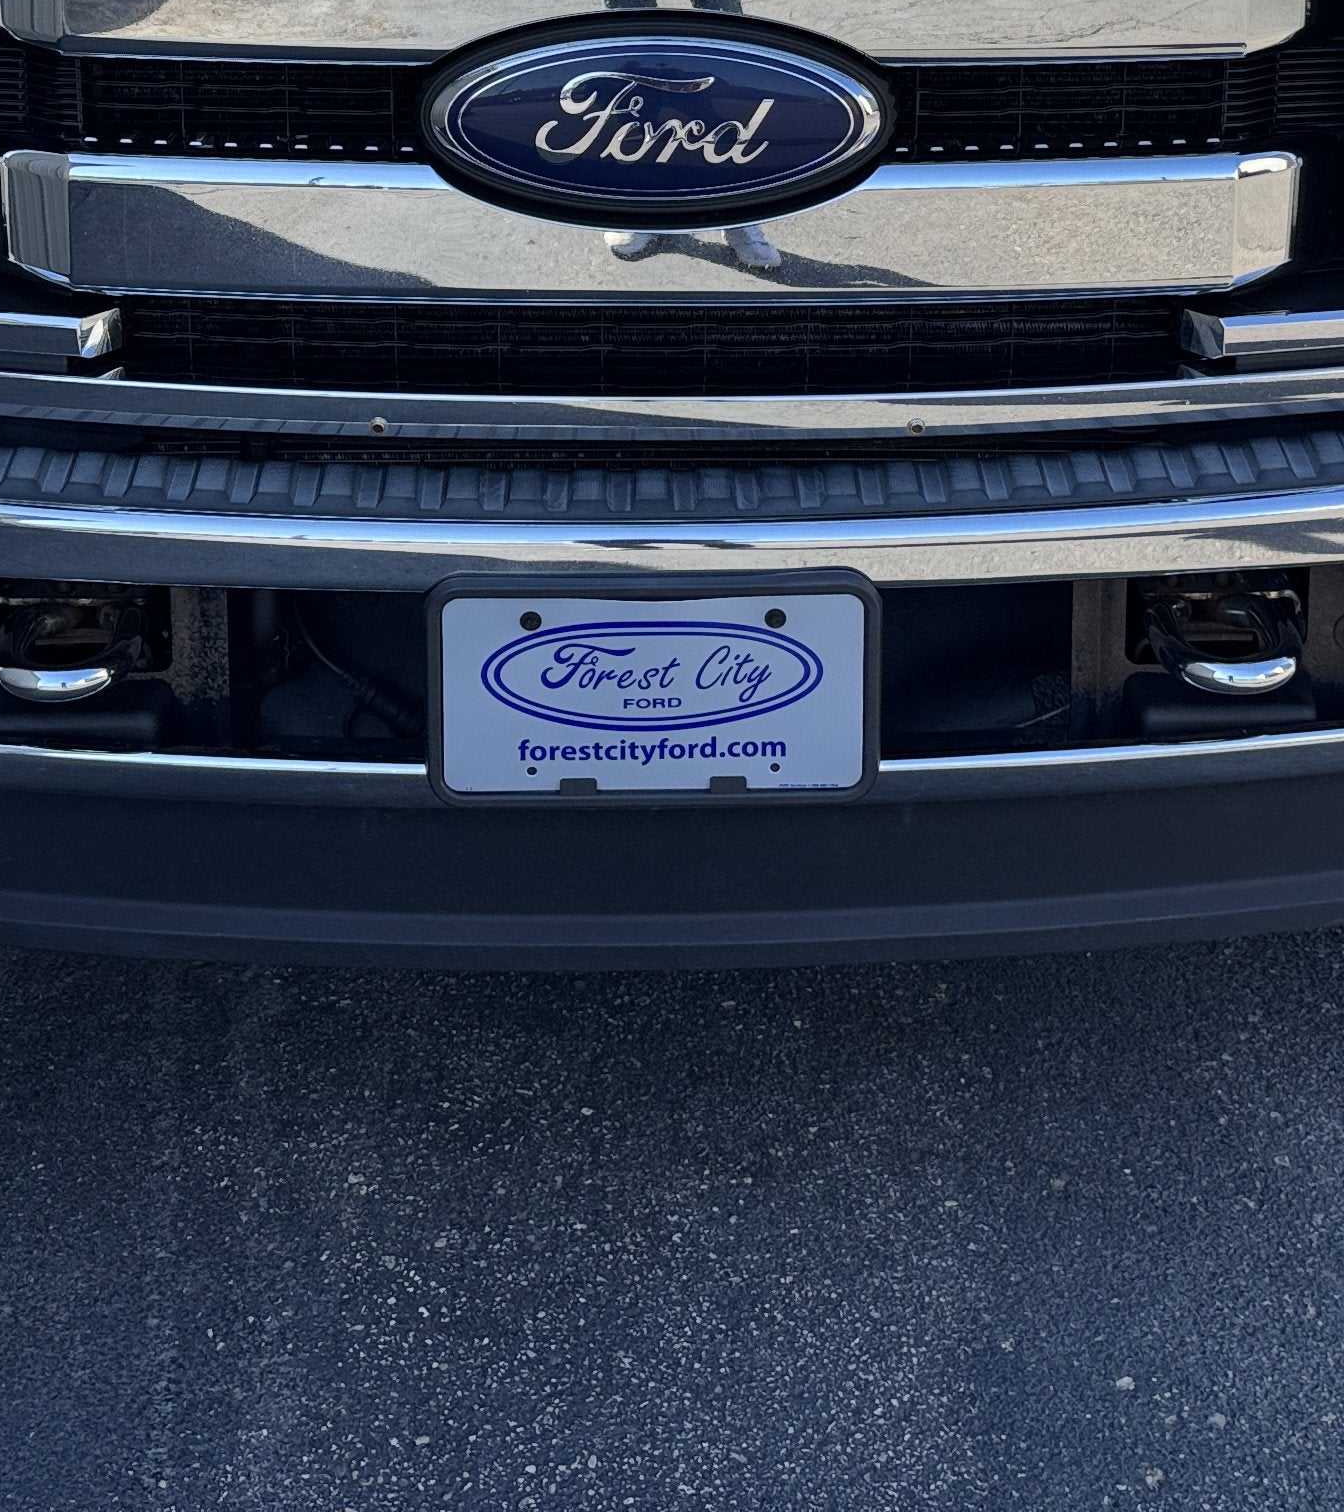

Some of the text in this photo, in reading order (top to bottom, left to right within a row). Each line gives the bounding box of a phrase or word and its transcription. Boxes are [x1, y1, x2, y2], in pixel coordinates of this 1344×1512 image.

[535, 71, 774, 165] Ford
[540, 643, 772, 703] Forest City
[623, 697, 682, 709] FORD
[518, 736, 787, 766] forestcityford.com
